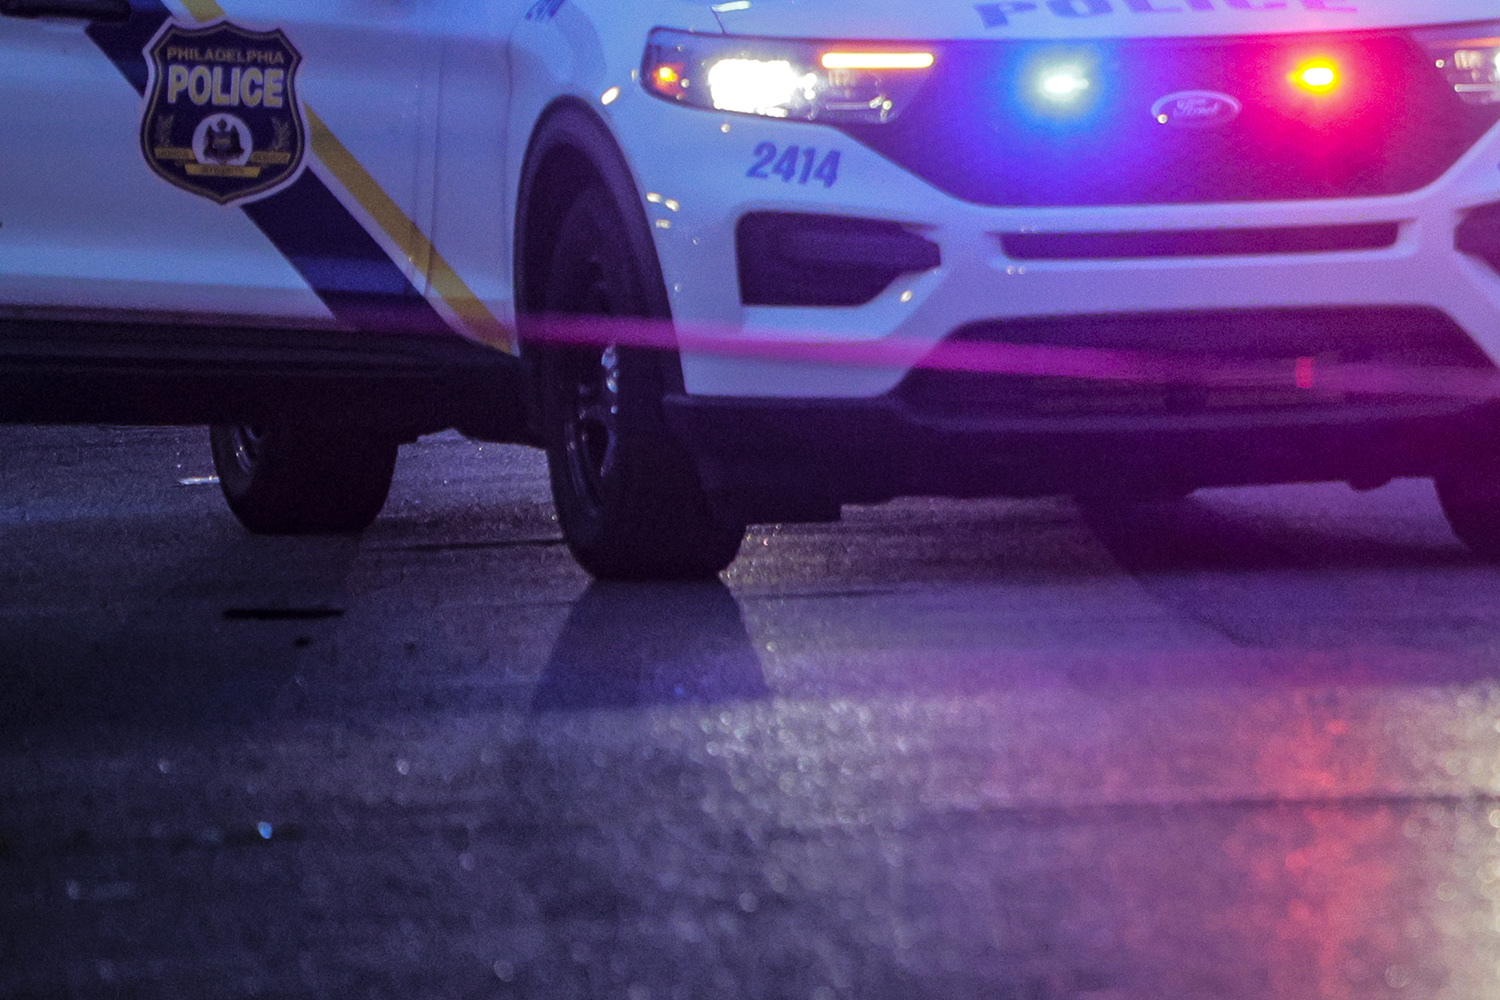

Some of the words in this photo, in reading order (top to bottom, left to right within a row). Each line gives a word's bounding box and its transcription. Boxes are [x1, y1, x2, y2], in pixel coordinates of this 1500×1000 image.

[166, 47, 284, 63] PHILADELPHIA
[168, 65, 284, 107] POLICE
[745, 141, 841, 189] 2414
